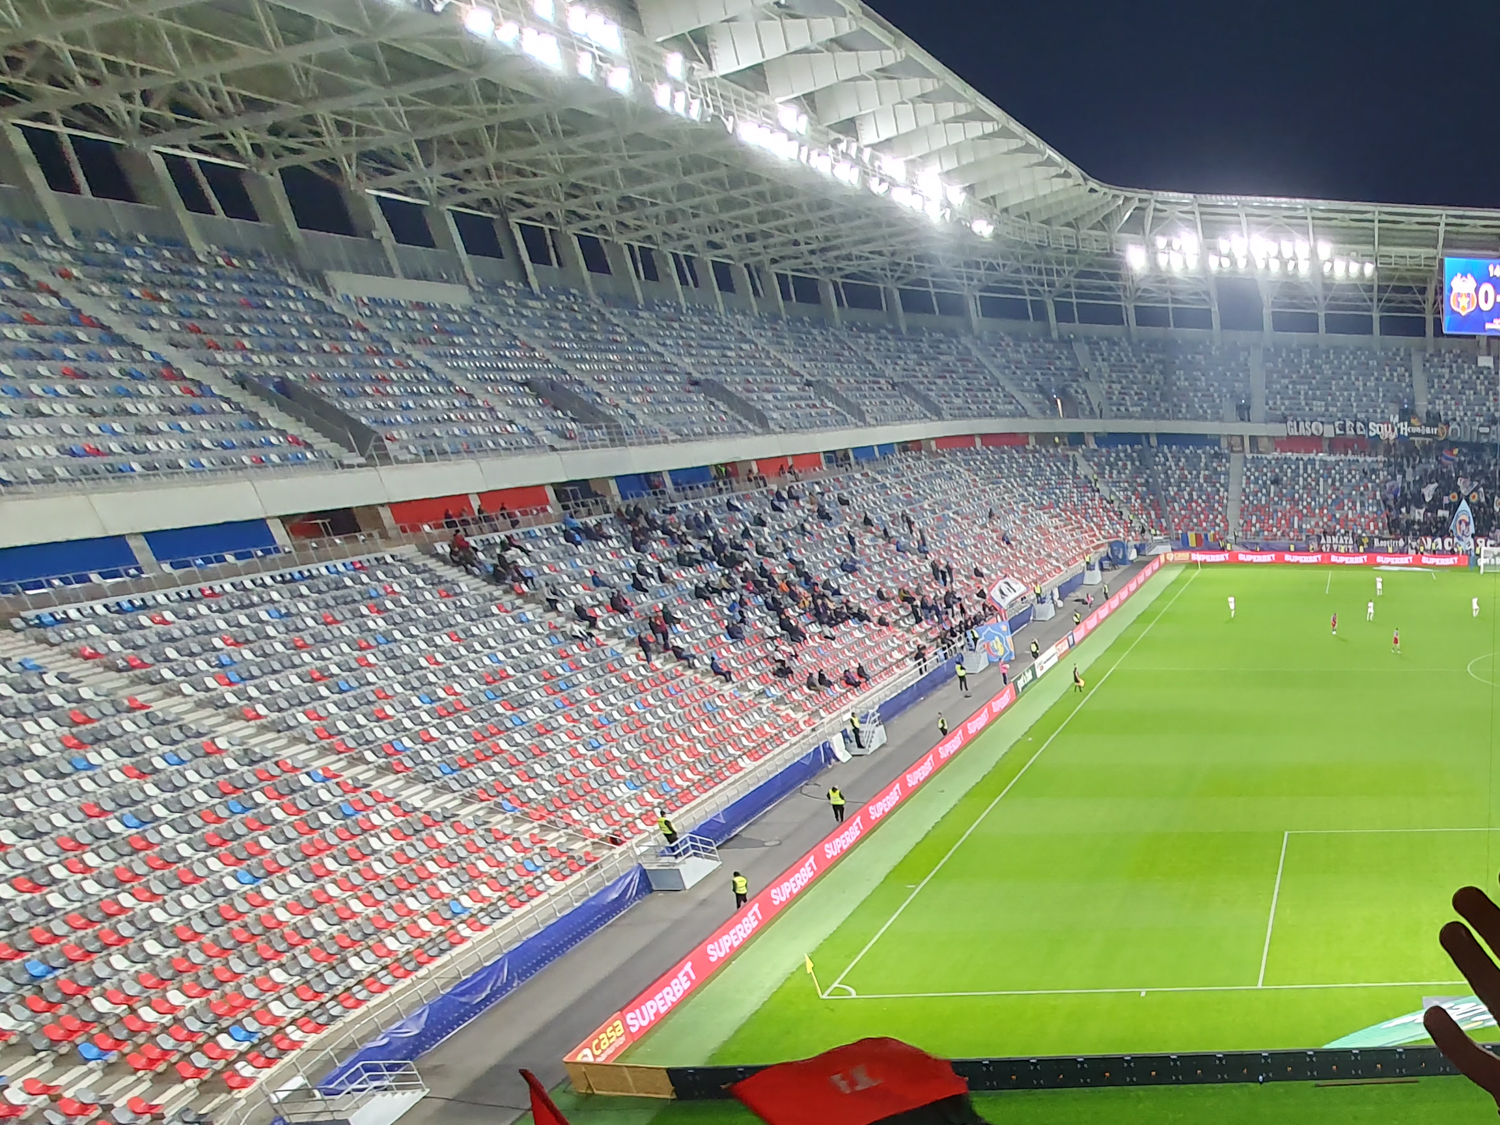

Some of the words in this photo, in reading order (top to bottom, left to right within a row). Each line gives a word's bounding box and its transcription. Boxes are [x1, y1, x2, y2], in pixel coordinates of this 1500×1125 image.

[906, 754, 935, 787] SUPERBET
[869, 783, 902, 820] SUPERBET
[824, 816, 864, 859] SUPERBET
[770, 855, 817, 905] SUPERBET
[706, 903, 763, 962] SUPERBET
[626, 961, 696, 1033] SUPERBET
